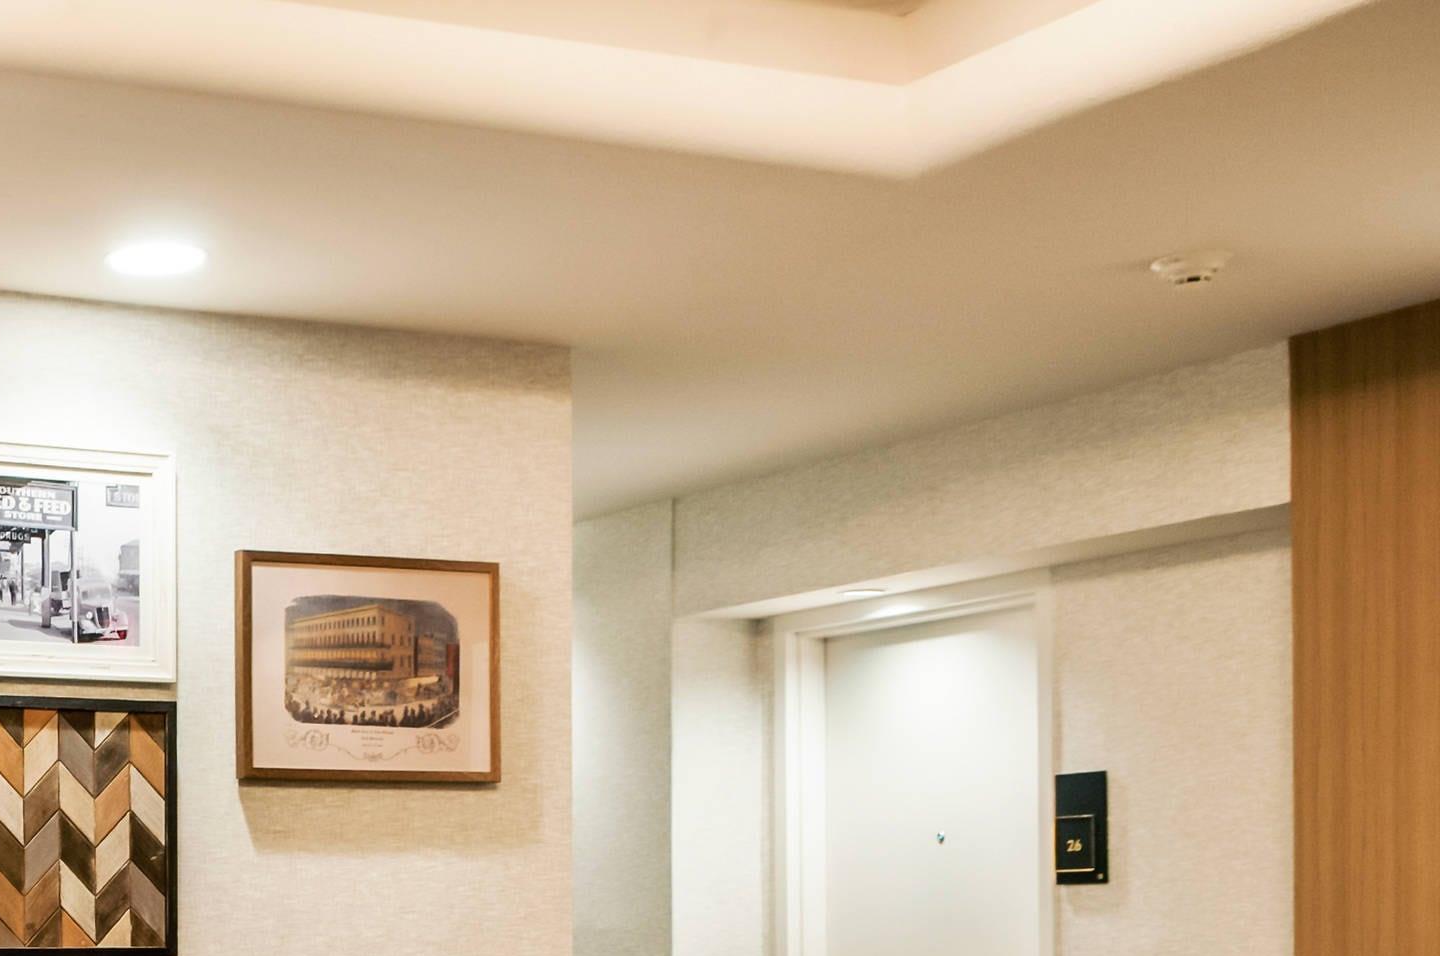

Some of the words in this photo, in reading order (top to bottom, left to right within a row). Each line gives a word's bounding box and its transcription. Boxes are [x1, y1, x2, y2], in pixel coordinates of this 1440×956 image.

[19, 497, 31, 511] &
[34, 499, 71, 515] FEED
[1066, 838, 1082, 852] 26
